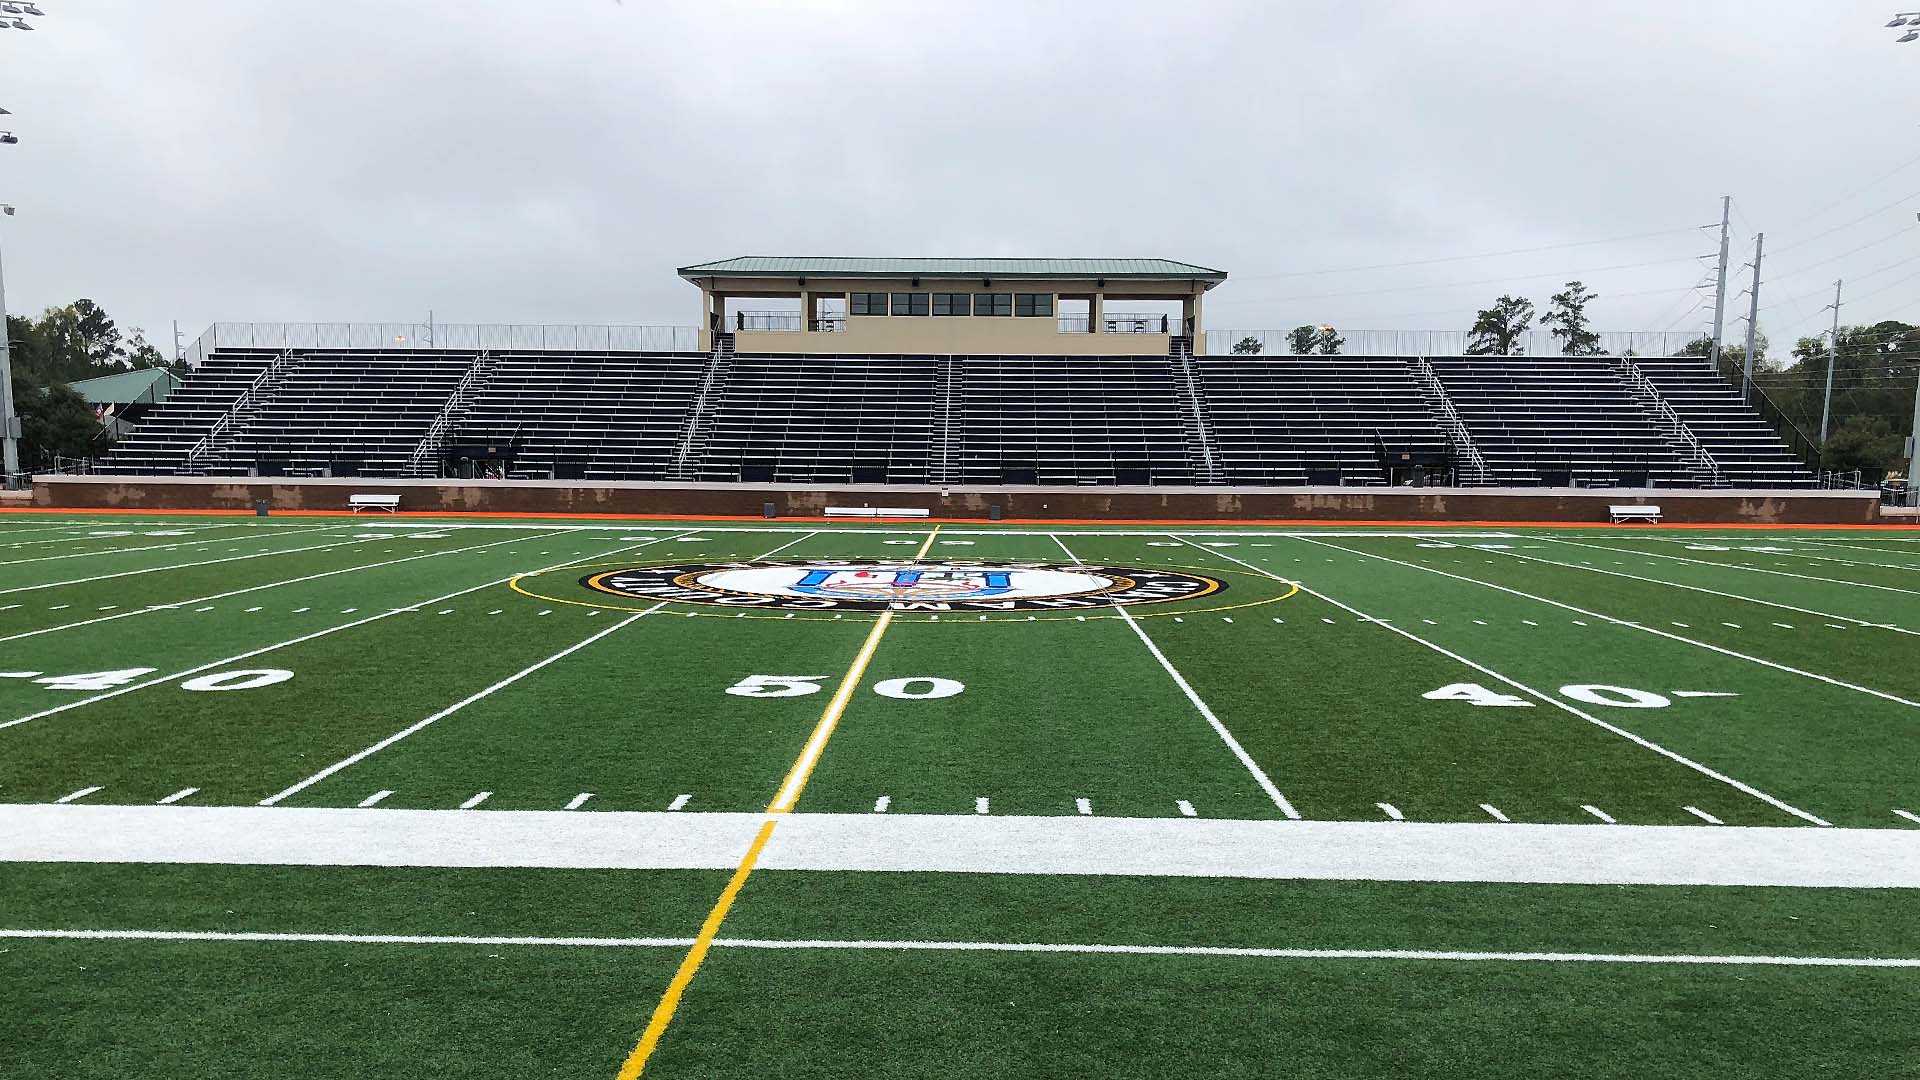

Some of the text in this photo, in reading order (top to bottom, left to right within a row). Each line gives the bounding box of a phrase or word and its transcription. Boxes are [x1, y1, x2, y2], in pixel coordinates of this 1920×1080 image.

[610, 576, 838, 609] COUNTY
[890, 579, 1200, 610] CHATHAM
[725, 675, 965, 699] 50
[1422, 683, 1671, 708] 40
